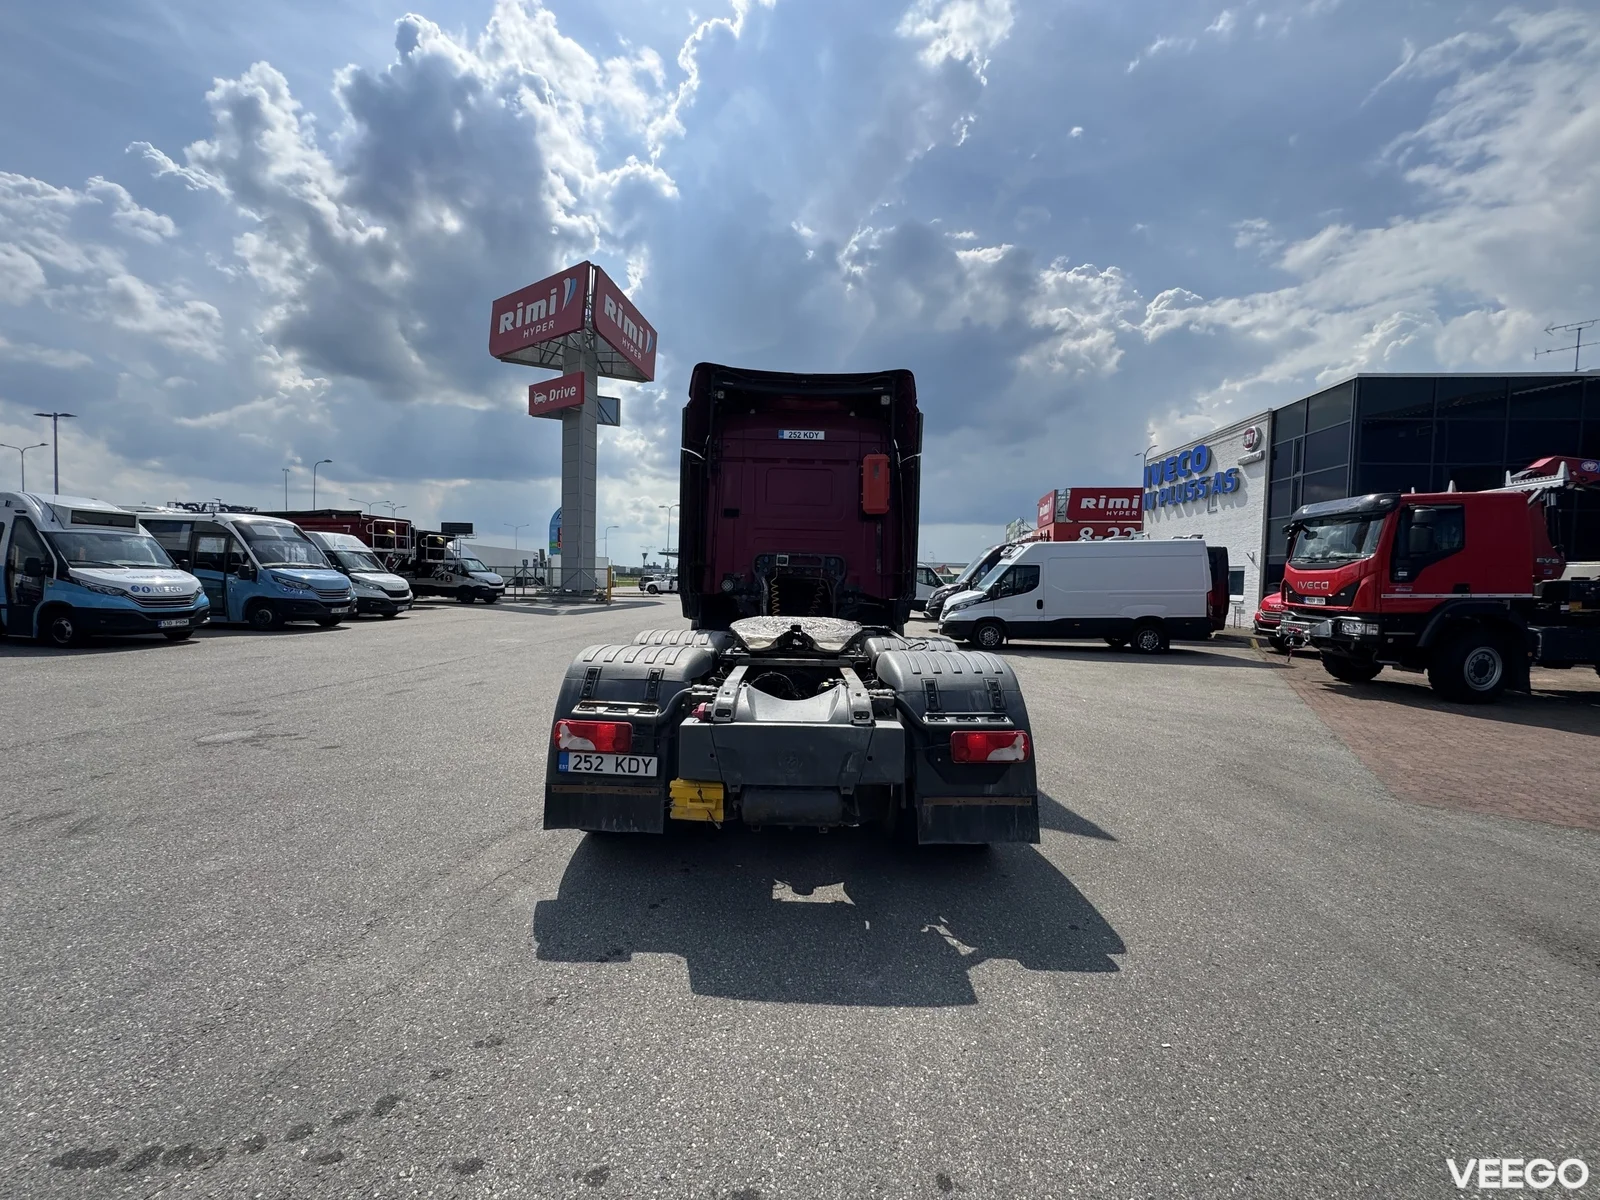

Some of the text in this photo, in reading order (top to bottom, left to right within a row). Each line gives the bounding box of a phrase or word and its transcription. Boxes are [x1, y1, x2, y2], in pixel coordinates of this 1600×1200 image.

[499, 288, 558, 334] Rimi
[605, 294, 644, 349] Rimi
[523, 320, 555, 339] HYPER
[622, 338, 643, 361] HYPER
[549, 385, 577, 402] Drive
[1144, 444, 1210, 488] IVECO
[1159, 477, 1208, 507] PLUSS
[1212, 468, 1239, 495] AS
[1080, 495, 1140, 509] Rimi
[1297, 581, 1329, 590] IVECO
[573, 754, 653, 774] 252 KDY
